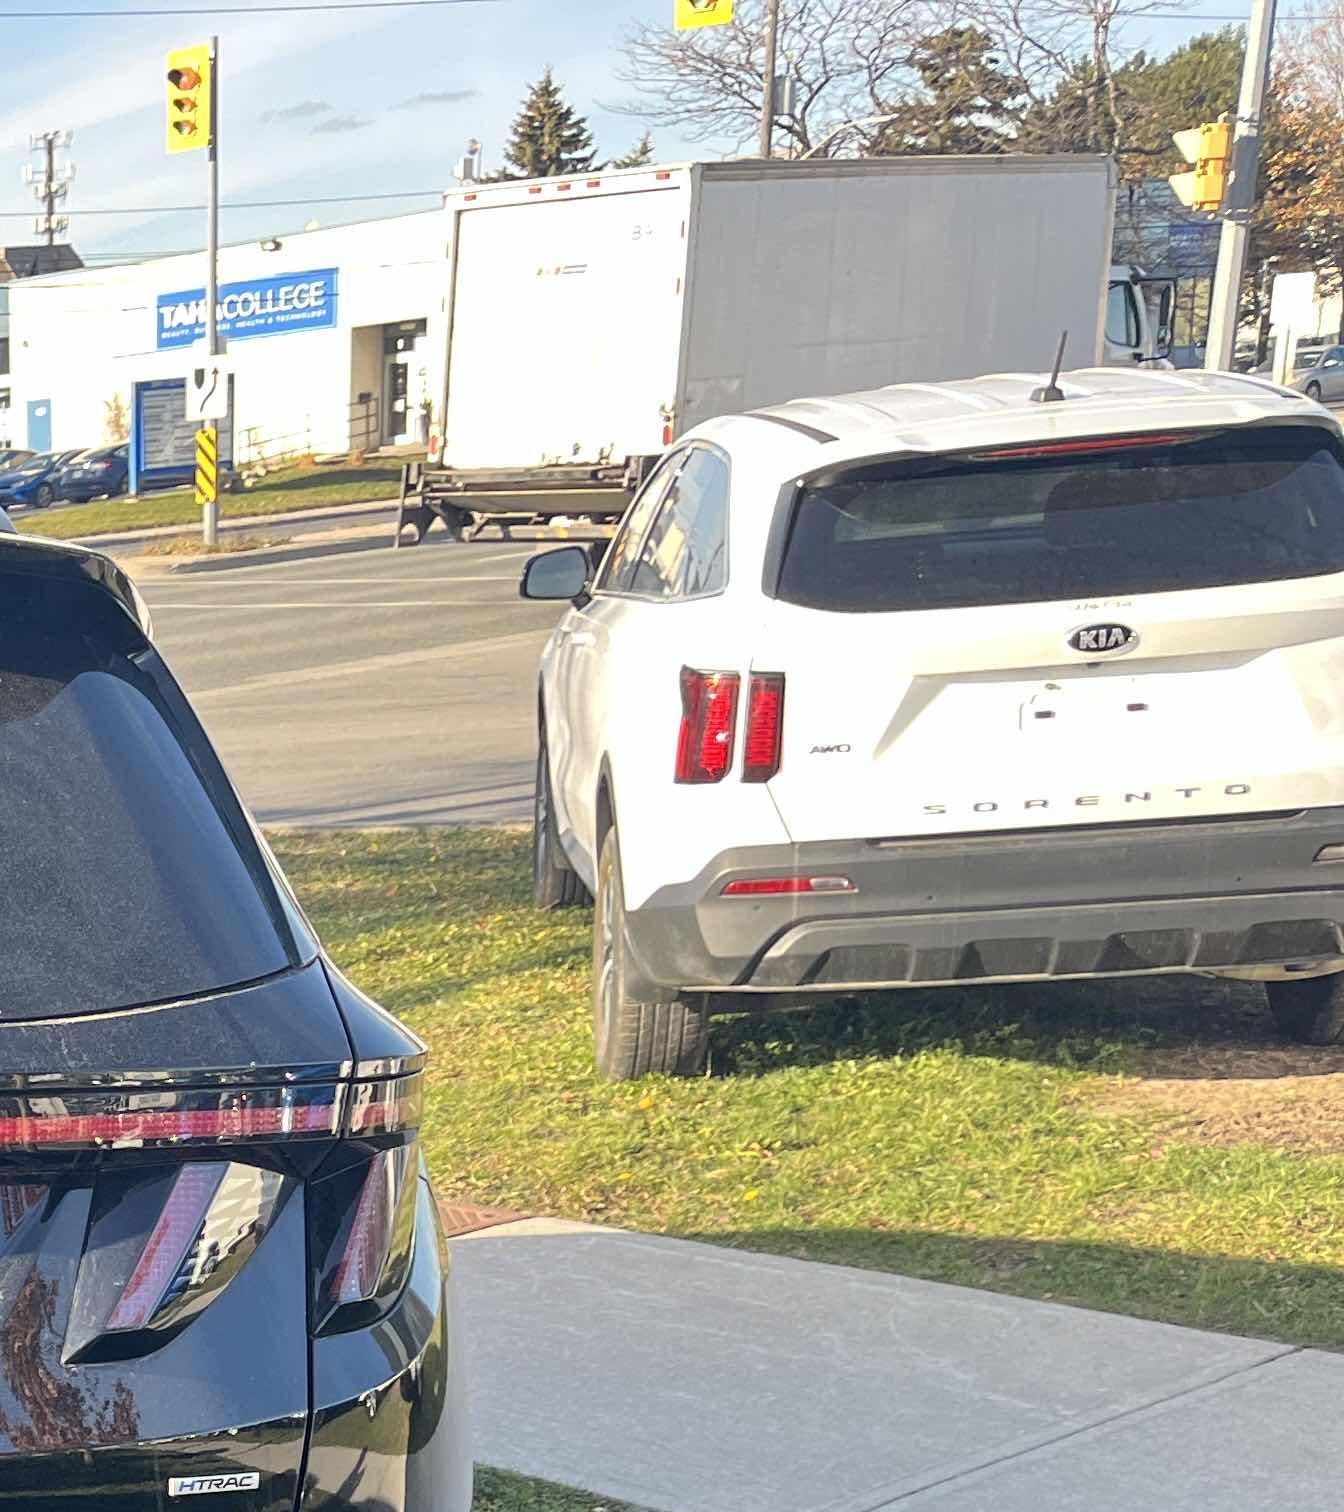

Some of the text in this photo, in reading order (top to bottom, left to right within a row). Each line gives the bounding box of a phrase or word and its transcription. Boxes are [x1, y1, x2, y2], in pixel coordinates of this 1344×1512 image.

[1079, 627, 1126, 649] KIA
[922, 782, 1251, 816] SORENTO
[178, 1475, 254, 1492] HTRAC
